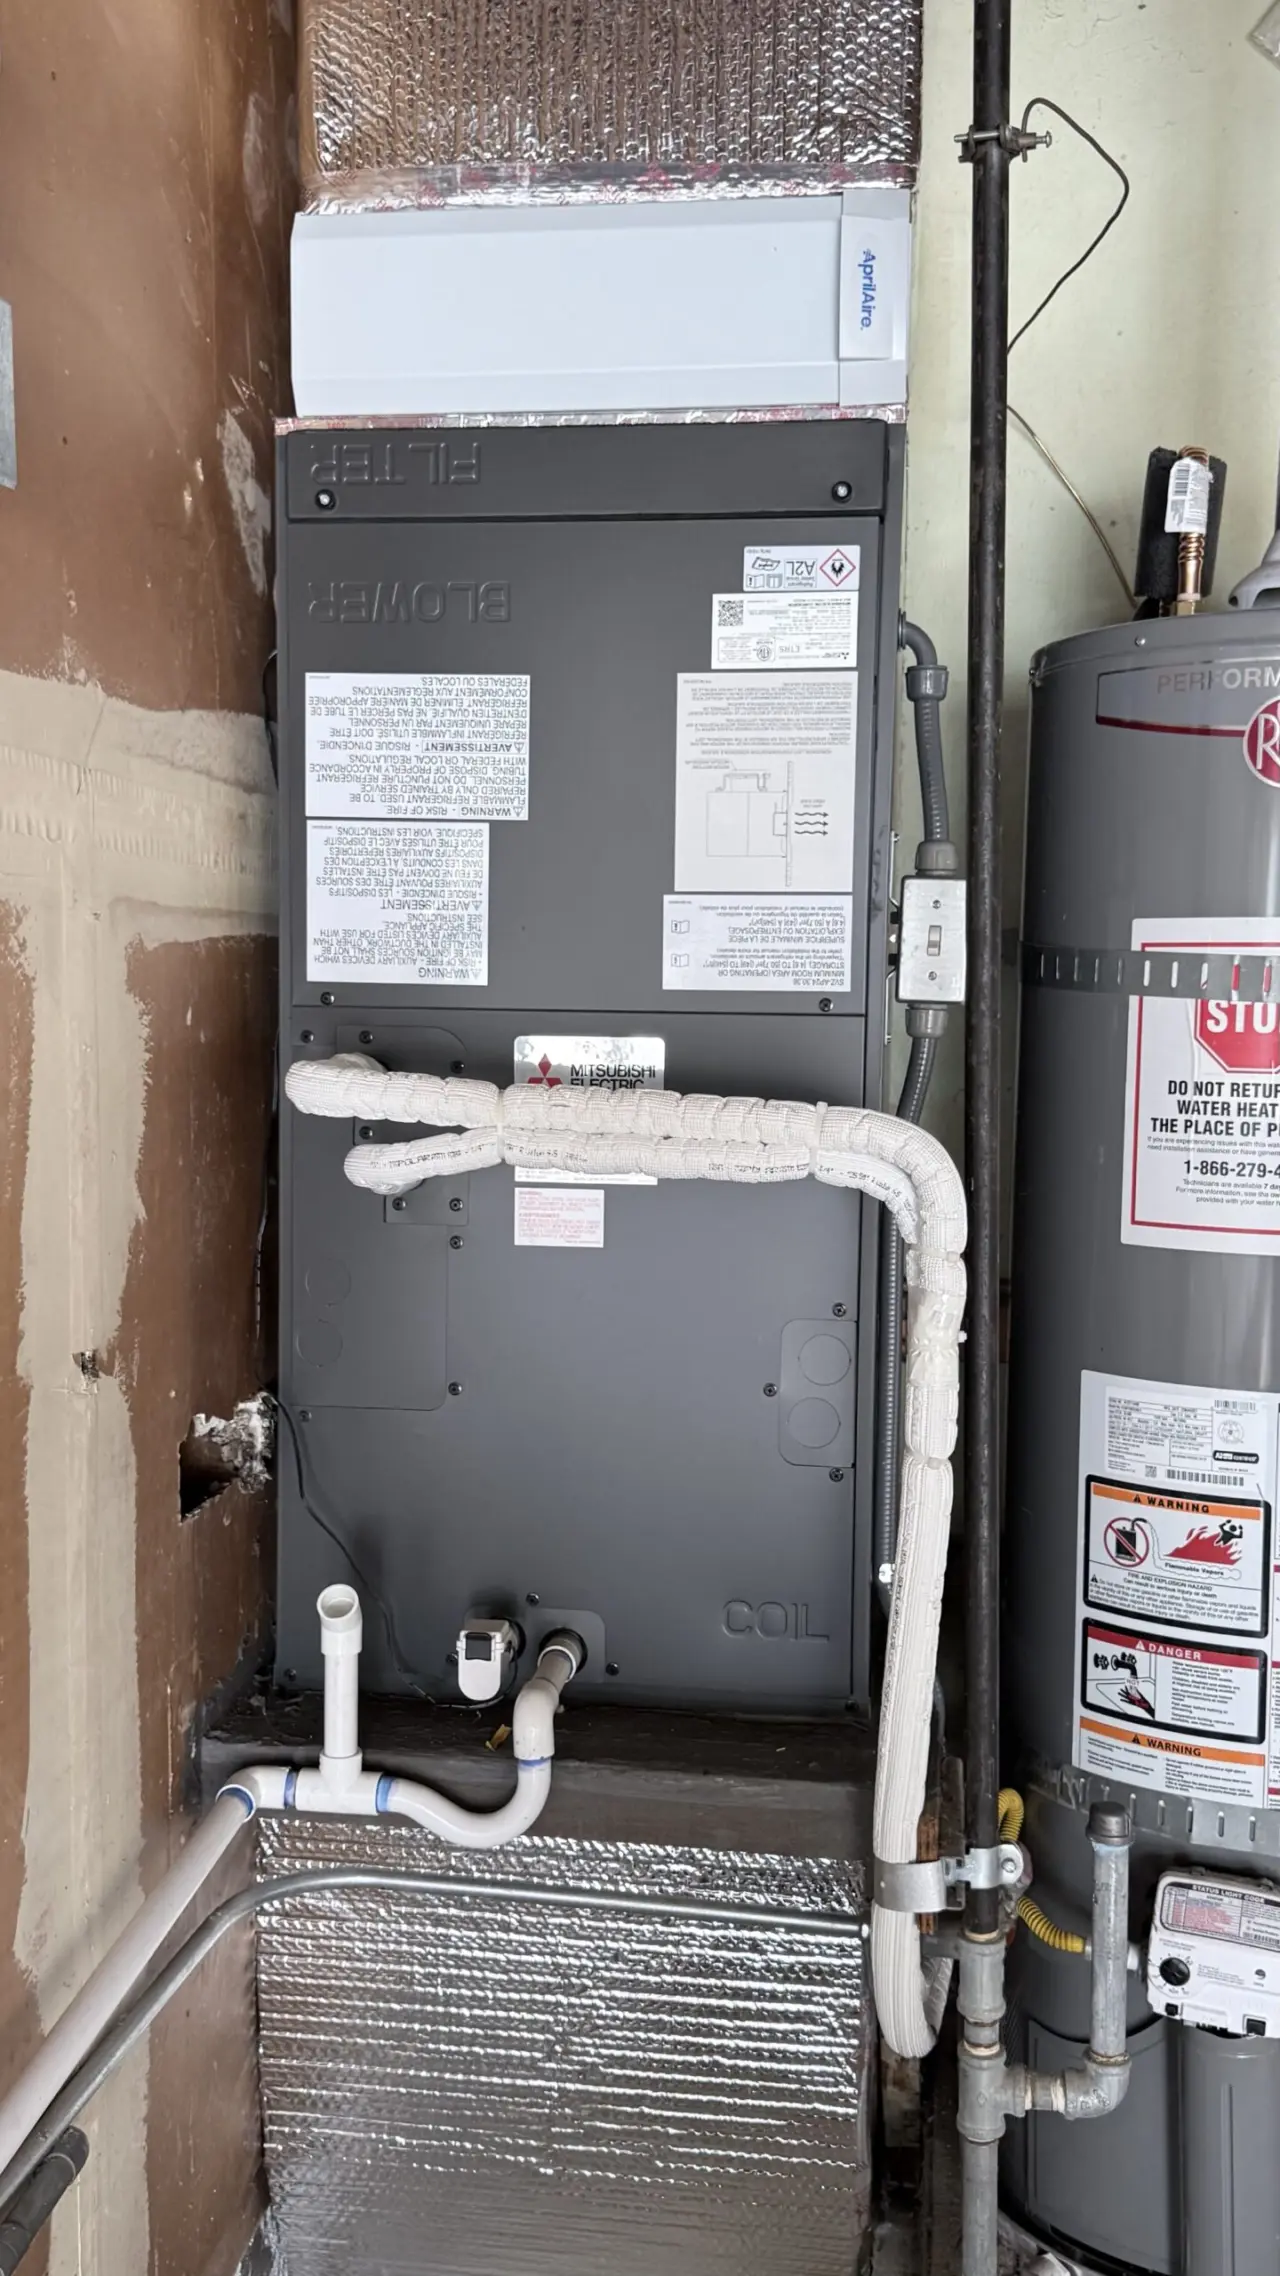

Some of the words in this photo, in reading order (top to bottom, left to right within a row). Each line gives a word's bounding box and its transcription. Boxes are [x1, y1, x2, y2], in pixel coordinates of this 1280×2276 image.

[858, 249, 876, 330] AprilAire
[310, 443, 480, 485] FILTER
[786, 561, 815, 575] A2L
[308, 581, 511, 623] BLOWER
[461, 678, 476, 687] OU
[436, 688, 453, 697] AUX
[411, 698, 422, 707] DE
[311, 707, 322, 716] DE
[325, 707, 345, 716] TUBE
[349, 707, 358, 716] LE
[361, 708, 395, 717] PERCER
[398, 708, 414, 717] PAS
[416, 708, 427, 718] NE
[350, 718, 400, 728] PERSONNEL
[403, 719, 414, 728] UN
[417, 719, 432, 728] PAR
[435, 720, 491, 729] UNIQUEMENT
[354, 729, 374, 738] DOIT
[375, 742, 411, 751] RISQUE
[425, 742, 512, 753] AVERTISSEMENT
[414, 756, 443, 765] LOCAL
[446, 756, 458, 765] OR
[461, 757, 502, 766] FEDERAL
[504, 757, 526, 766] WITH
[310, 764, 371, 773] ACCORDANCE
[373, 765, 382, 774] IN
[385, 765, 431, 774] PROPERLY
[434, 766, 446, 775] OF
[449, 766, 488, 775] DISPOSE
[317, 774, 379, 783] REFRIGERANT
[382, 775, 430, 784] PUNCTURE
[433, 776, 451, 784] NOT
[454, 776, 466, 785] DO
[361, 784, 399, 793] SERVICE
[402, 785, 438, 794] TRAINED
[443, 786, 453, 794] BY
[456, 786, 479, 795] ONLY
[482, 786, 526, 796] REPAIRED
[350, 794, 361, 802] BE
[363, 794, 375, 803] TO
[407, 795, 470, 804] REFRIGERANT
[472, 796, 526, 805] FLAMMABLE
[412, 806, 424, 815] OF
[427, 806, 448, 815] RISK
[462, 807, 511, 816] WARNING
[397, 828, 412, 837] LES
[316, 877, 354, 887] SOURCES
[356, 878, 372, 887] DES
[397, 879, 433, 888] POUVANT
[330, 888, 376, 898] DISPOSITIFS
[379, 889, 393, 898] LES
[381, 899, 471, 911] AVERTISSEMENT
[321, 929, 340, 938] WITH
[342, 930, 358, 938] USE
[360, 930, 375, 938] FOR
[378, 930, 404, 939] LISTED
[407, 931, 440, 940] DEVICES
[315, 955, 340, 964] WHICH
[426, 958, 444, 966] FIRE
[419, 968, 470, 979] WARNING
[1206, 1000, 1280, 1033] STO
[570, 1064, 656, 1078] MITSUBISHI
[1168, 1080, 1188, 1095] DO
[1193, 1081, 1225, 1097] NOT
[1178, 1100, 1231, 1116] WATER
[1151, 1118, 1178, 1133] THE
[1184, 1120, 1234, 1136] PLACE
[1240, 1122, 1261, 1137] OF
[1267, 1122, 1280, 1137] P
[1147, 1496, 1210, 1513] WARNING
[1165, 1562, 1200, 1573] Flammable
[1202, 1567, 1224, 1576] Vapors
[722, 1600, 830, 1642] COIL
[1149, 1643, 1201, 1660] DANGER
[1147, 1738, 1201, 1757] WARNING
